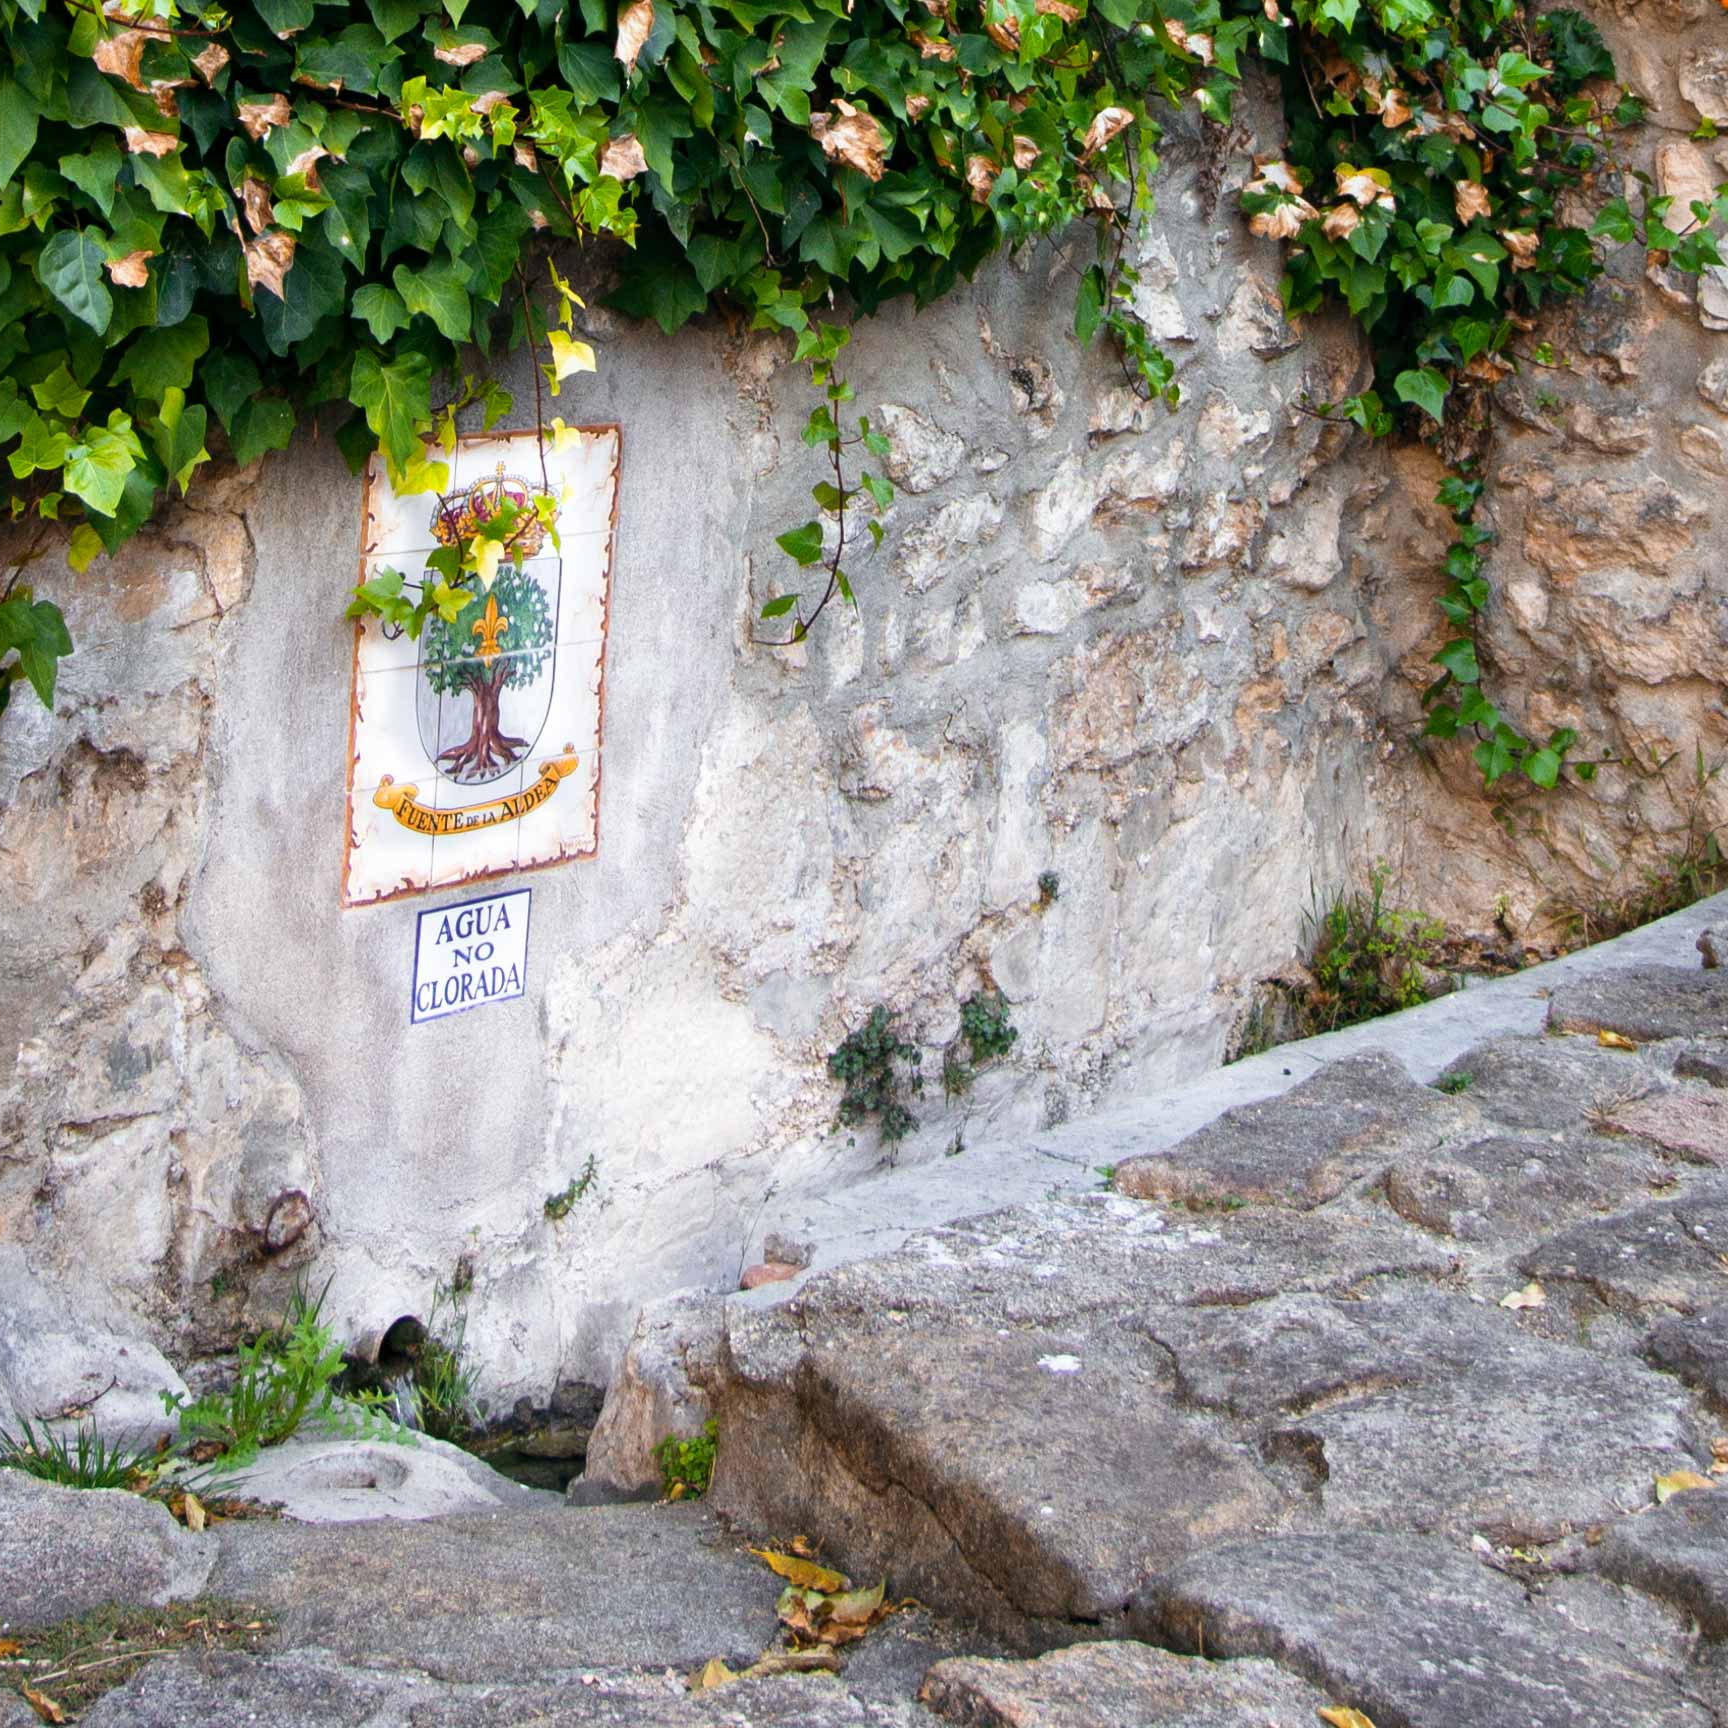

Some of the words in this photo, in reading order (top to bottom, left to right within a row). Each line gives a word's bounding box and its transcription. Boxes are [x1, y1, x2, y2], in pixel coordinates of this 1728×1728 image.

[396, 799, 463, 833] FUENTE
[466, 814, 481, 828] DE
[482, 809, 497, 824] LA
[500, 776, 560, 821] ALDEA
[435, 902, 511, 945] AGUA
[452, 941, 495, 968] NO
[416, 962, 521, 1012] CLORADA
